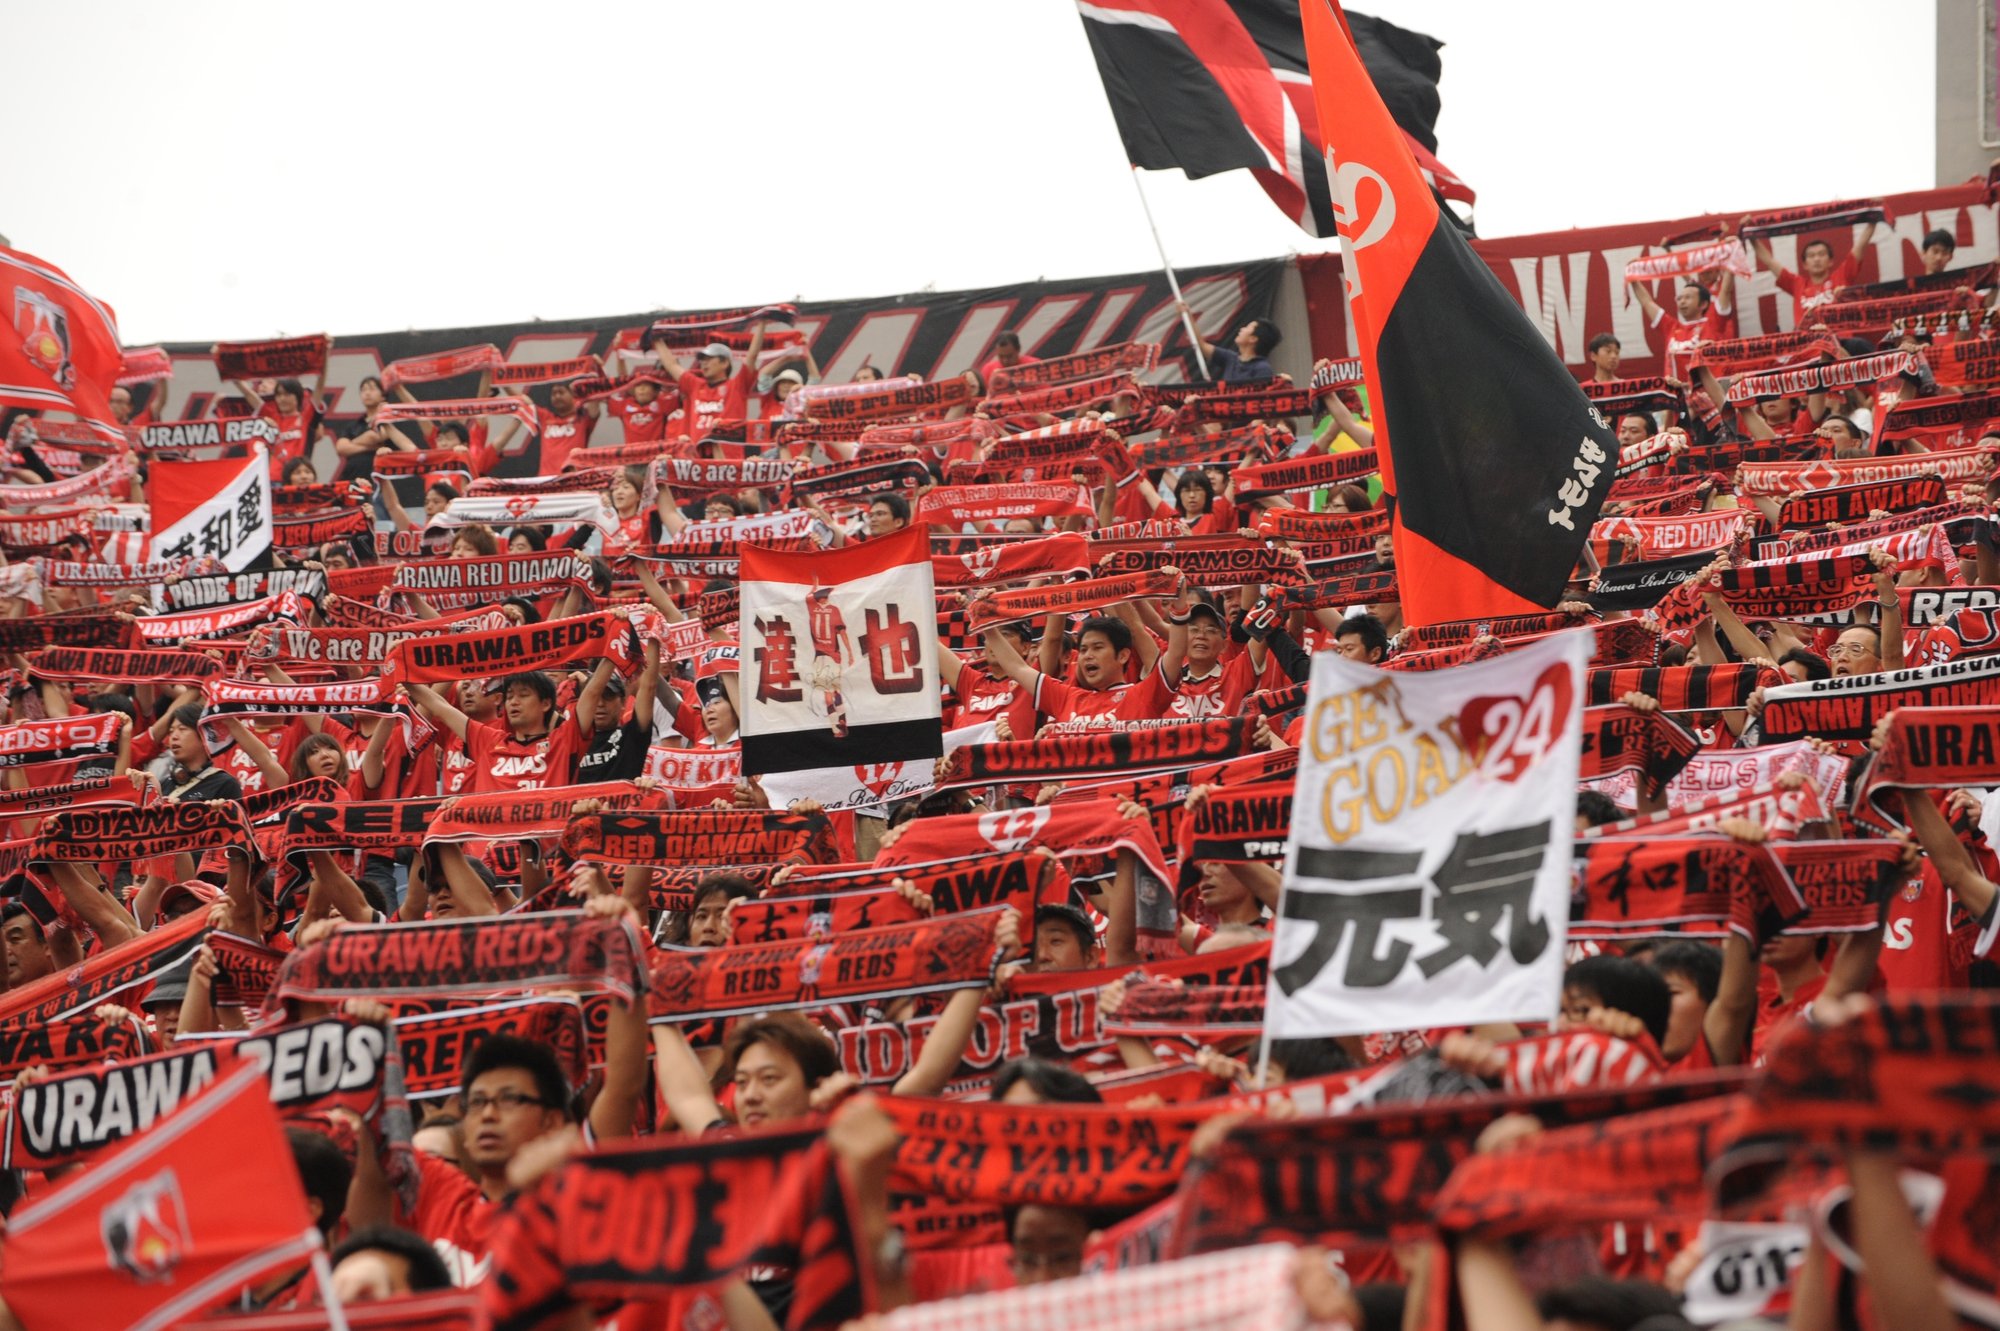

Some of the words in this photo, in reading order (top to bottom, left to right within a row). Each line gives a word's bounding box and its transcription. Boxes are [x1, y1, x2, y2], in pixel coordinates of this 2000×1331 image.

[1313, 360, 1364, 389] URAWA
[140, 423, 220, 448] URAWA
[225, 419, 280, 443] REDS
[672, 459, 707, 482] We
[709, 463, 735, 482] are
[1261, 464, 1306, 488] URAWA
[1310, 459, 1333, 481] RED
[1743, 470, 1791, 493] MUFC
[1853, 465, 1887, 484] RED
[952, 507, 971, 519] We
[974, 507, 993, 518] are
[996, 504, 1037, 517] REDS!
[1652, 524, 1686, 549] RED
[1799, 530, 1841, 550] AWA
[55, 560, 125, 581] URAWA
[129, 557, 183, 579] REDS
[466, 560, 504, 586] RED
[968, 552, 996, 569] 12
[169, 576, 230, 609] PRIDE
[235, 572, 259, 601] OF
[1006, 593, 1047, 611] URAWA
[1050, 590, 1073, 608] RED
[1076, 580, 1136, 602] DIAMONDS
[1595, 577, 1636, 595] Urawa
[814, 612, 832, 640] 11
[1247, 600, 1276, 630] 20
[1417, 624, 1471, 642] URAWA
[1492, 616, 1547, 636] URAWA
[286, 629, 323, 661] We
[326, 637, 364, 661] are
[413, 628, 525, 668] URAWA
[532, 616, 607, 657] REDS
[90, 650, 125, 676] RED
[460, 664, 487, 675] We
[490, 660, 517, 673] are
[519, 651, 562, 668] REDS!
[322, 677, 380, 700] RED
[278, 704, 310, 714] ARE
[1310, 676, 1413, 764] GET
[1484, 683, 1553, 778] 24
[1905, 722, 2000, 767] URA
[984, 732, 1114, 772] URAWA
[1127, 721, 1232, 763] REDS
[660, 758, 691, 781] OF
[862, 763, 898, 786] 12
[1667, 757, 1760, 791] EDS
[441, 803, 503, 825] URAWA
[510, 802, 543, 822] RED
[659, 812, 764, 834] URAWA
[992, 810, 1039, 843] 12
[56, 842, 91, 859] RED
[109, 840, 133, 858] IN
[604, 835, 656, 857] RED
[664, 829, 811, 857] DIAMONDS
[931, 855, 1029, 913] AWA
[1793, 860, 1879, 884] URAWA
[1274, 819, 1553, 998] 元気
[1804, 884, 1867, 905] REDS
[326, 928, 463, 974] URAWA
[474, 922, 570, 968] REDS
[725, 967, 782, 996] REDS
[837, 953, 898, 982] REDS
[20, 1052, 218, 1154] URAWA
[238, 1021, 386, 1104] REDS
